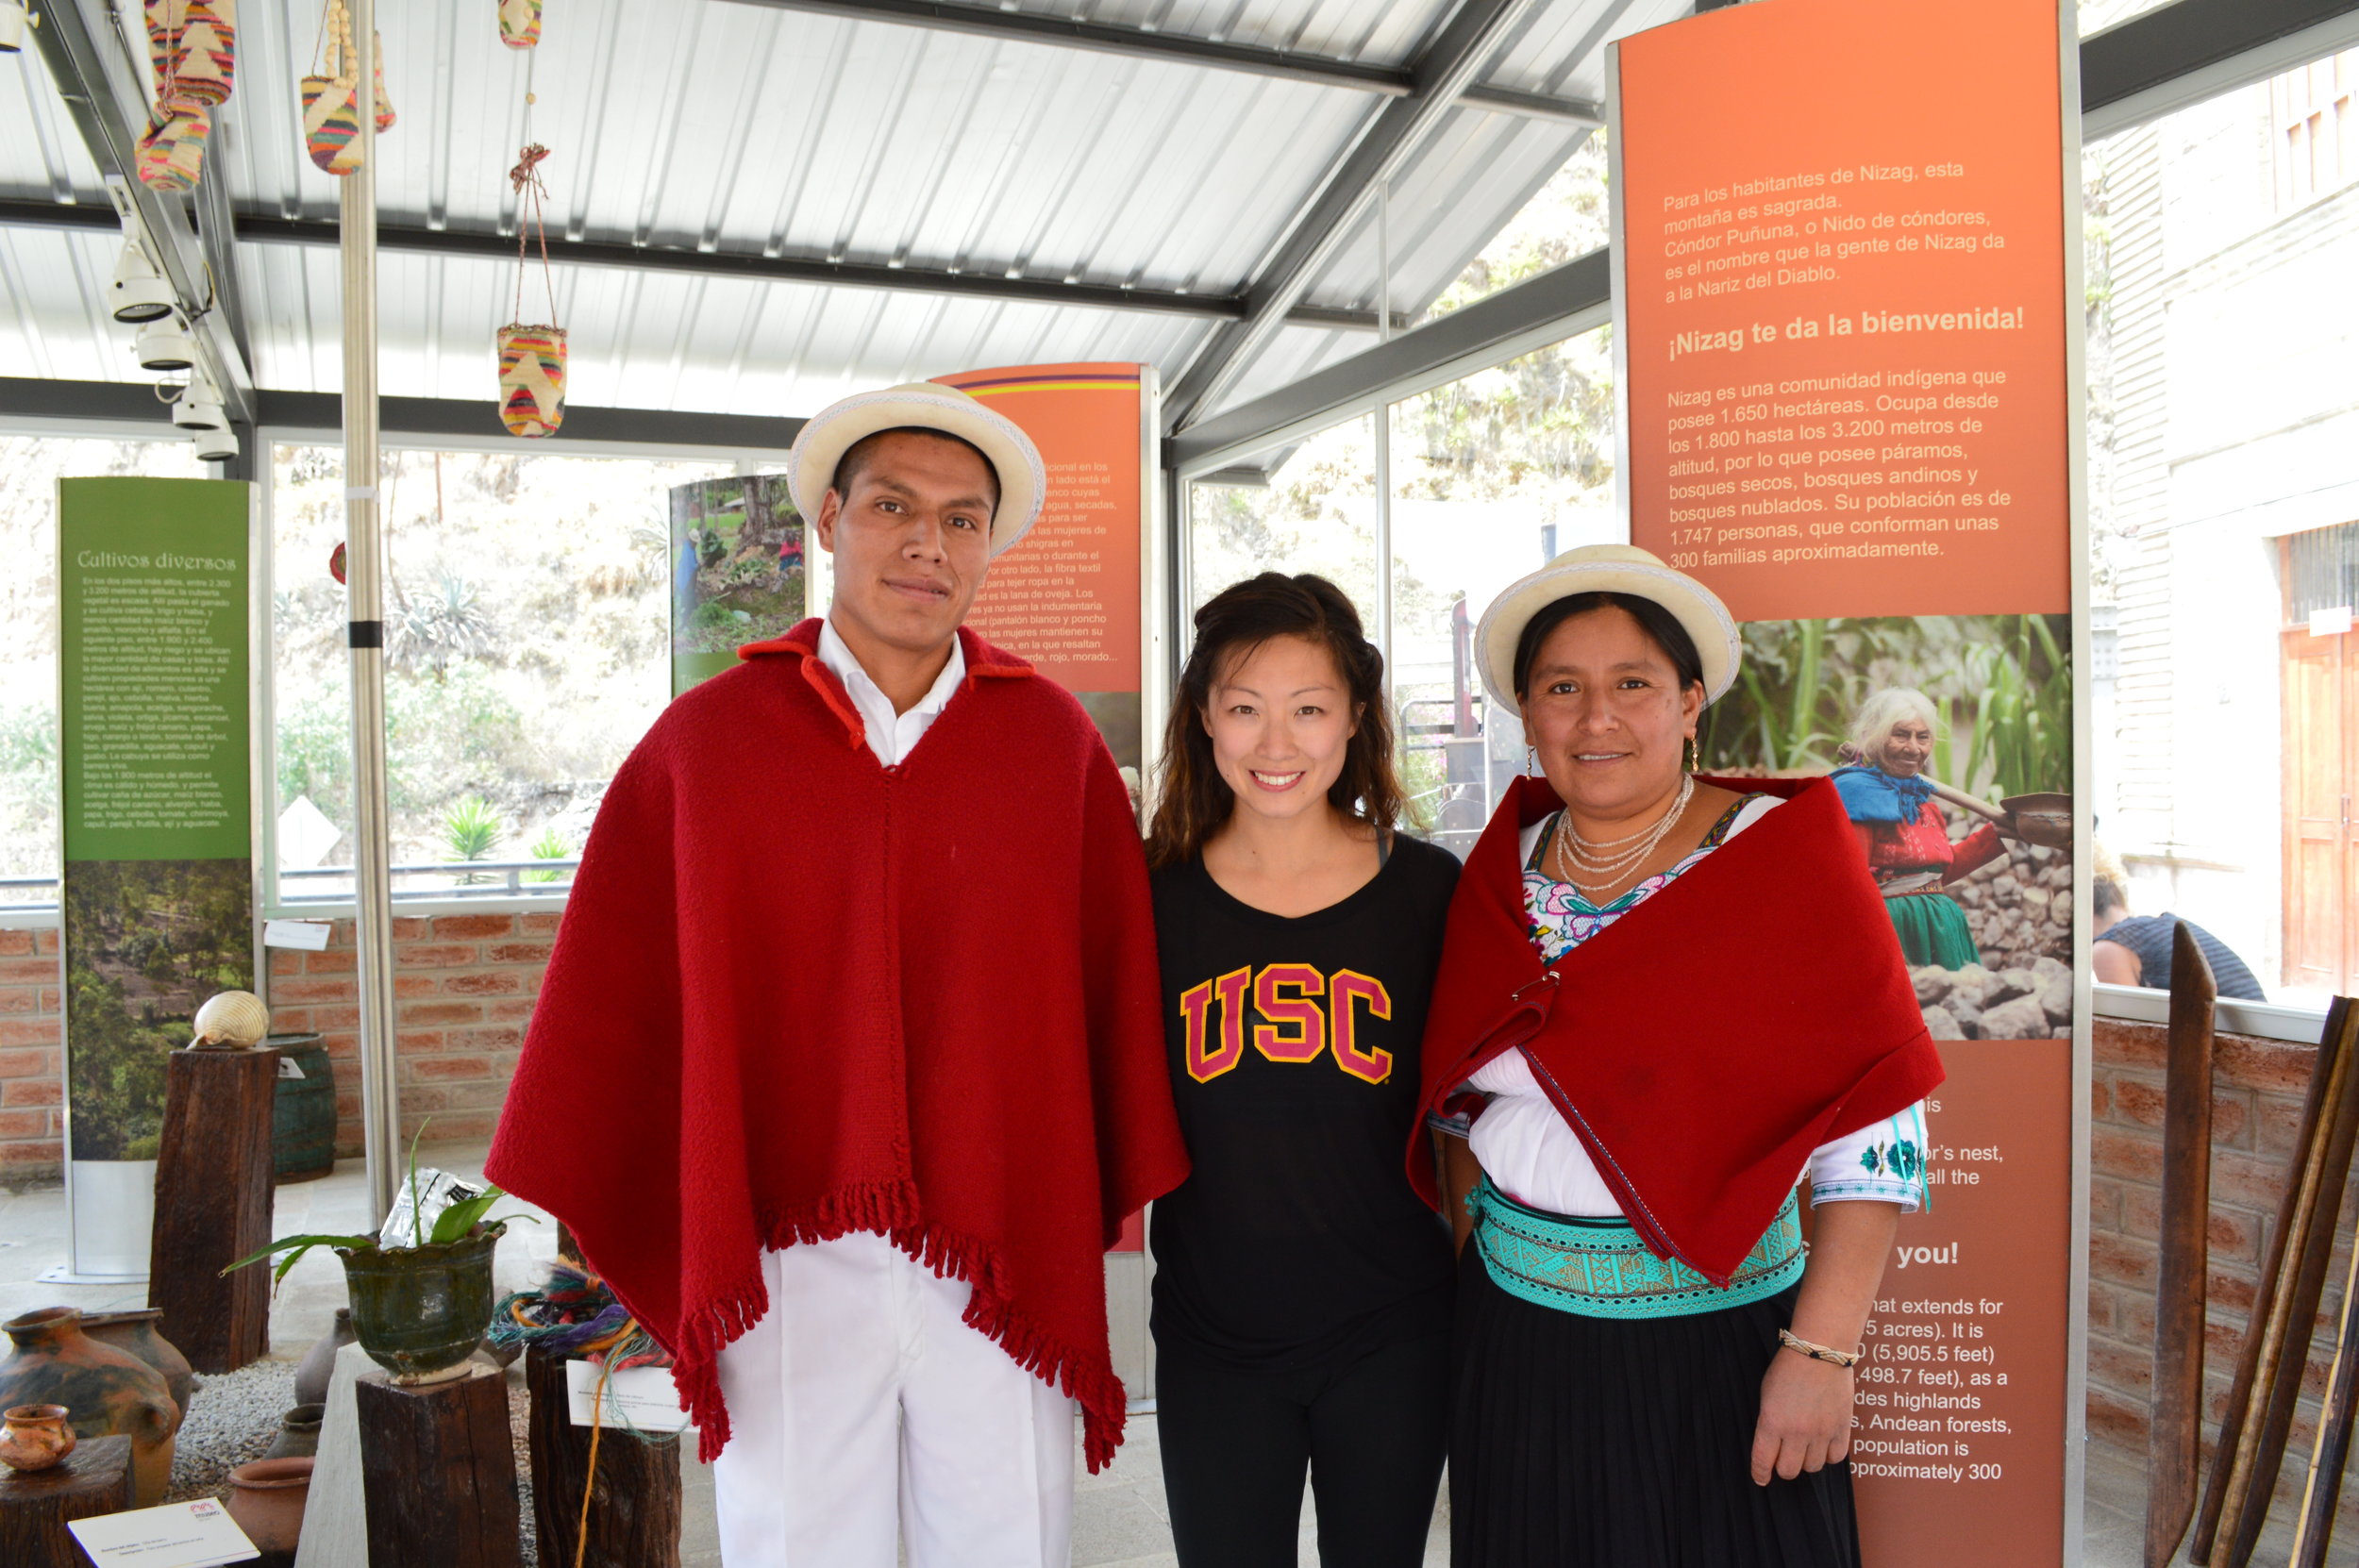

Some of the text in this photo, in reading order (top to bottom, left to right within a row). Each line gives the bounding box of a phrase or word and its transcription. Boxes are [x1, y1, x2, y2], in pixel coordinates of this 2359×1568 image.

[1664, 160, 1964, 212] Para los habitantes de Nizag, esta
[1664, 193, 1843, 235] montaña es sagrada.
[1665, 209, 1990, 258] Cóndor Puñuna, o Nido de cóndores,
[1665, 232, 2005, 280] es el nombre que la gente de Nizag da
[1665, 265, 1841, 304] a la Nariz del Diablo.
[1669, 306, 2024, 362] ¡Nizag te da la bienvenida!
[1667, 369, 2007, 409] Nizag es una comunidad indígena que
[1667, 392, 1999, 435] posee 1.650 hectáreas. Ocupa desde
[1668, 416, 1983, 454] los 1.800 hasta los 3.200 metros de
[1094, 462, 1109, 472] los
[1668, 442, 1967, 477] altitud, por lo que posee páramos,
[1057, 475, 1112, 484] lado está el
[1669, 466, 1979, 500] bosques secos, bosques andinos y
[1071, 490, 1100, 499] cuyas
[1046, 501, 1117, 512] agua, secadas,
[1669, 489, 2012, 524] bosques nublados. Su población es de
[1048, 514, 1070, 525] para
[1037, 526, 1051, 535] las
[1053, 525, 1093, 537] mujeres
[1094, 525, 1107, 534] de
[1670, 515, 1999, 546] 1.747 personas, que conforman unas
[1026, 539, 1060, 549] shigras
[1670, 540, 1945, 569] 300 familias aproximadamente.
[77, 550, 237, 572] Cultivos diversos
[1051, 552, 1088, 560] durante
[1001, 563, 1101, 575] otro lado, la fibra textil
[987, 577, 1063, 591] para tejer ropa en
[1010, 589, 1094, 600] lana oveja. Los
[1007, 603, 1102, 612] usan indumentaria
[989, 615, 1107, 627] (pantalón blanco poncho
[1002, 627, 1089, 639] mujeres mantienen
[1043, 640, 1101, 651] que resaltan
[1049, 653, 1070, 663] rojo,
[1180, 963, 1393, 1086] USC
[1960, 1145, 2003, 1163] nest,
[1926, 1169, 1981, 1185] all the
[1897, 1242, 1959, 1269] you!
[1901, 1298, 1975, 1314] extends
[1979, 1298, 2004, 1314] for
[1882, 1322, 1946, 1342] acres).
[1952, 1322, 1965, 1339] It
[1968, 1322, 1984, 1339] is
[1872, 1343, 1949, 1363] (5,905.5
[1952, 1345, 1995, 1366] feet)
[1917, 1368, 1965, 1390] feet),
[1969, 1373, 1992, 1386] as
[1996, 1373, 2008, 1386] a
[1893, 1391, 1982, 1412] highlands
[1869, 1413, 1941, 1432] Andean
[1946, 1416, 2012, 1435] forests,
[1853, 1439, 1970, 1457] population is
[1849, 1461, 2002, 1484] pproximately 300
